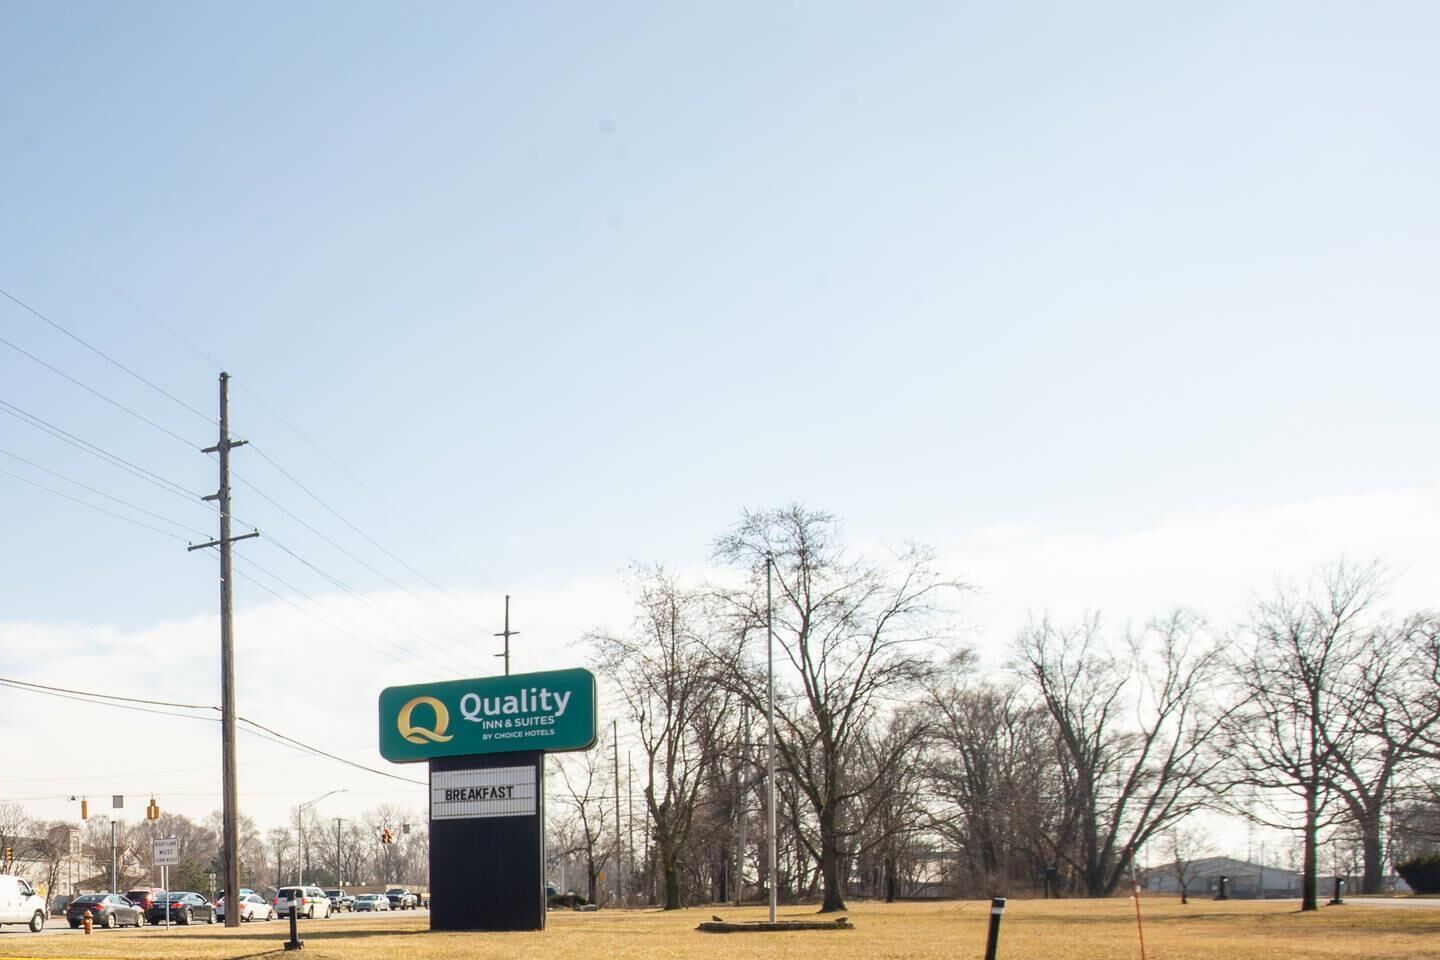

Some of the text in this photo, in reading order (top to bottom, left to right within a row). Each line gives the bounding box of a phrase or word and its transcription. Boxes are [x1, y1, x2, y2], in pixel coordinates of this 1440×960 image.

[460, 687, 572, 722] Quality
[482, 715, 555, 730] INN & SUITES
[494, 731, 523, 739] CHOICE
[524, 729, 555, 737] HOTELS
[445, 786, 514, 801] BREAKFAST
